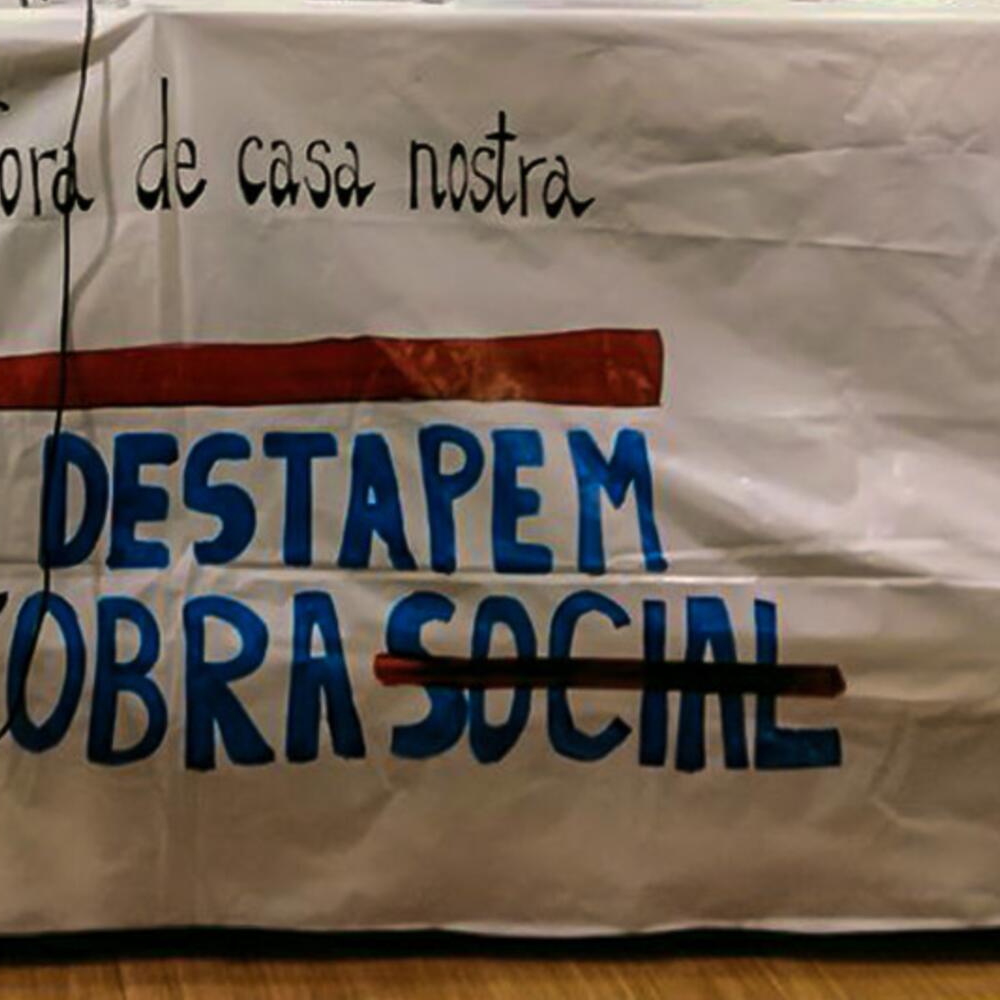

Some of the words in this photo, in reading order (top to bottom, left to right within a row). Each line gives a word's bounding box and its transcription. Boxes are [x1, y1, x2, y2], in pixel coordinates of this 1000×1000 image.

[136, 76, 208, 211] de
[237, 135, 376, 209] casa
[408, 109, 597, 219] nostra
[39, 424, 669, 576] DESTAPEM
[386, 587, 844, 774] SOCIAL
